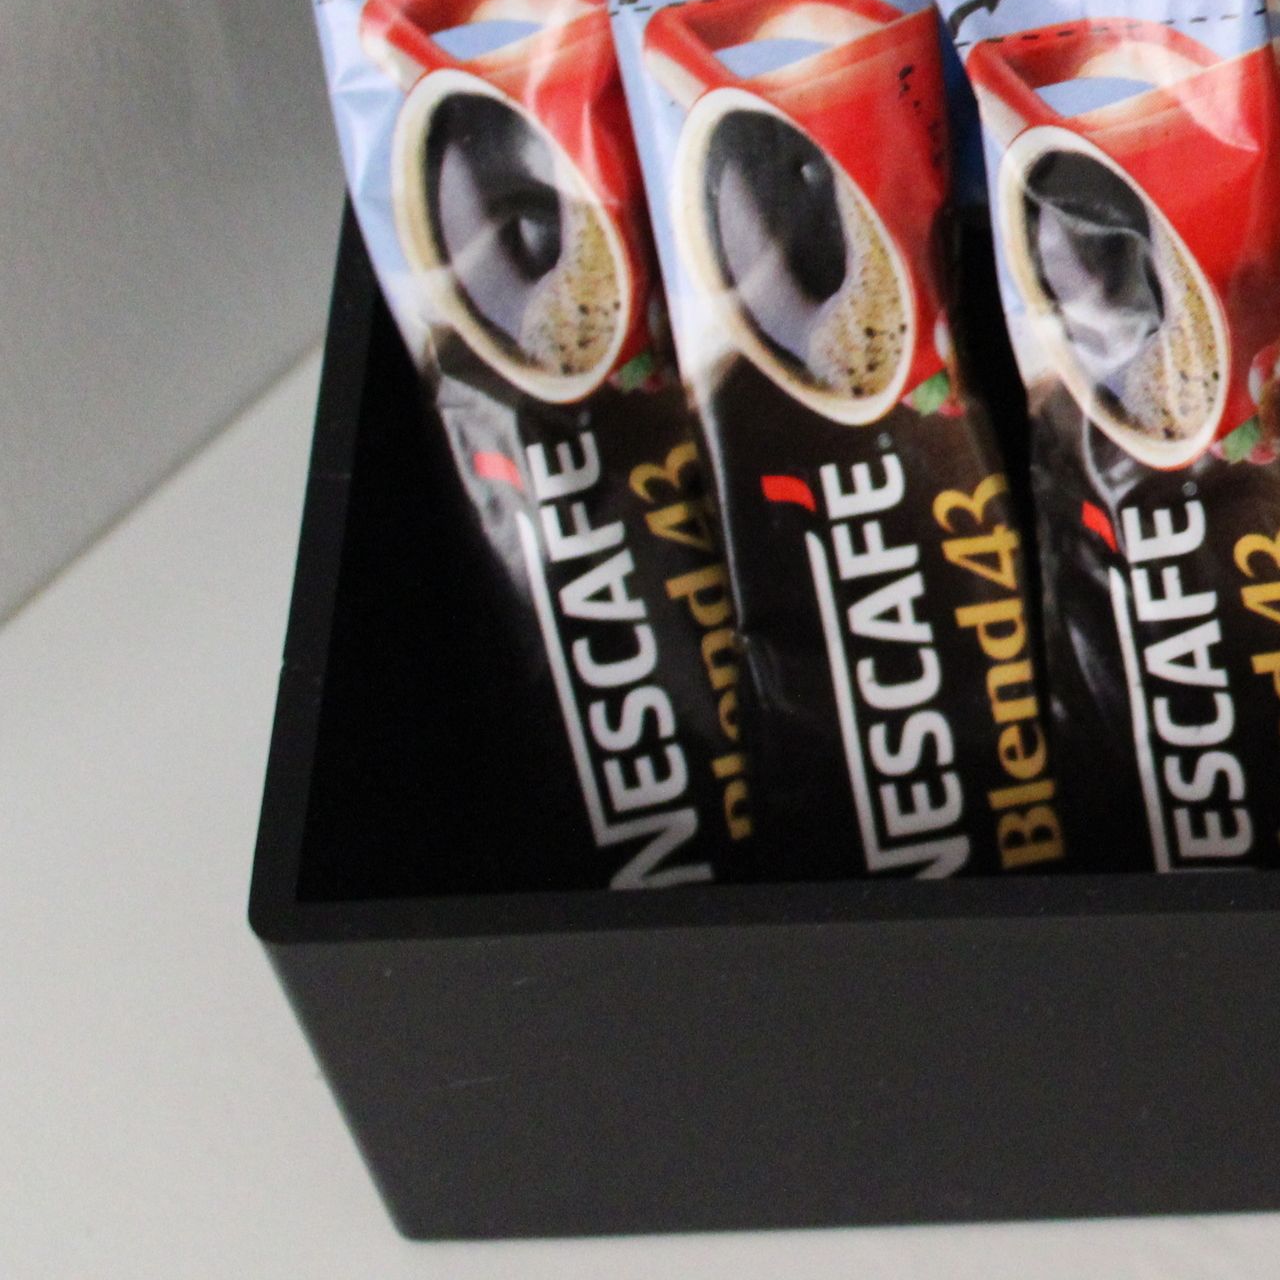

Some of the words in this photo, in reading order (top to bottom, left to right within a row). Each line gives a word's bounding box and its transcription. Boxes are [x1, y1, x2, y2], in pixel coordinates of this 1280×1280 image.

[932, 473, 1020, 591] 43
[955, 597, 1065, 869] Blend
[1081, 499, 1253, 874] ESCAFÉ
